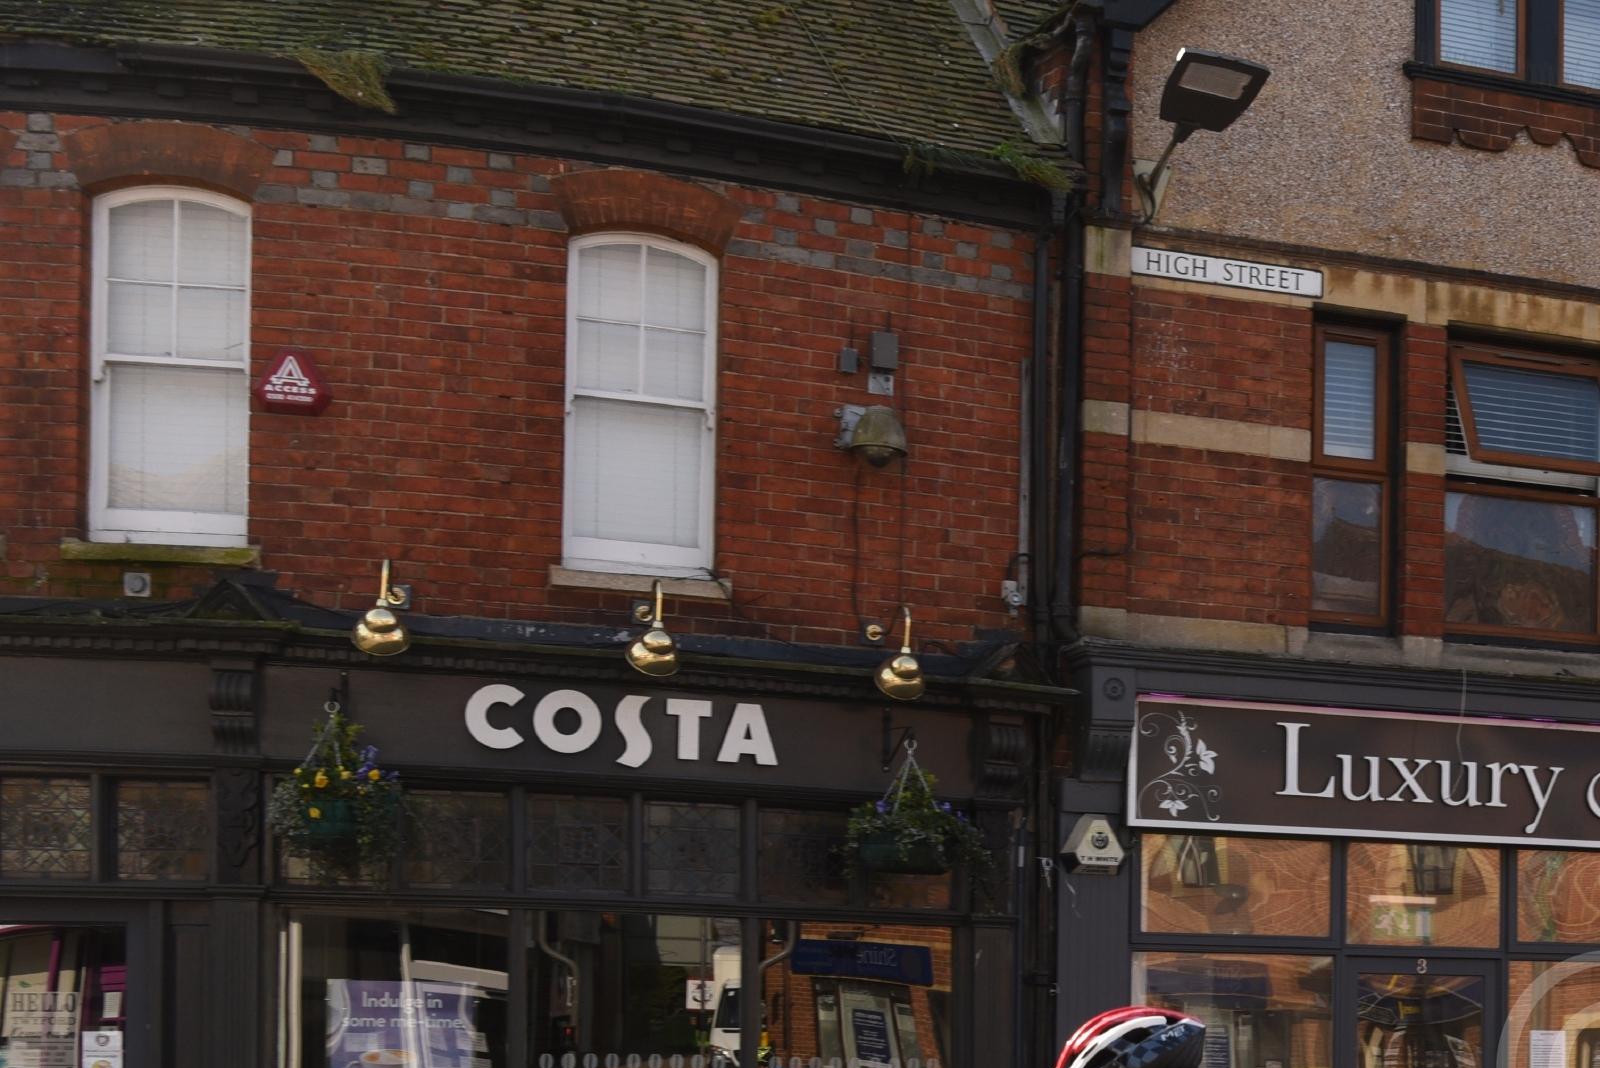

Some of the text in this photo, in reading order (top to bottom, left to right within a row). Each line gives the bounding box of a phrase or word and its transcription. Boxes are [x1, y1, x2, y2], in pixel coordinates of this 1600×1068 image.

[1145, 251, 1305, 291] HIGH STREET
[464, 683, 779, 769] COSTA
[1275, 721, 1565, 834] Luxury
[1416, 958, 1428, 974] 3
[427, 993, 443, 1009] in
[1160, 1025, 1186, 1042] MET
